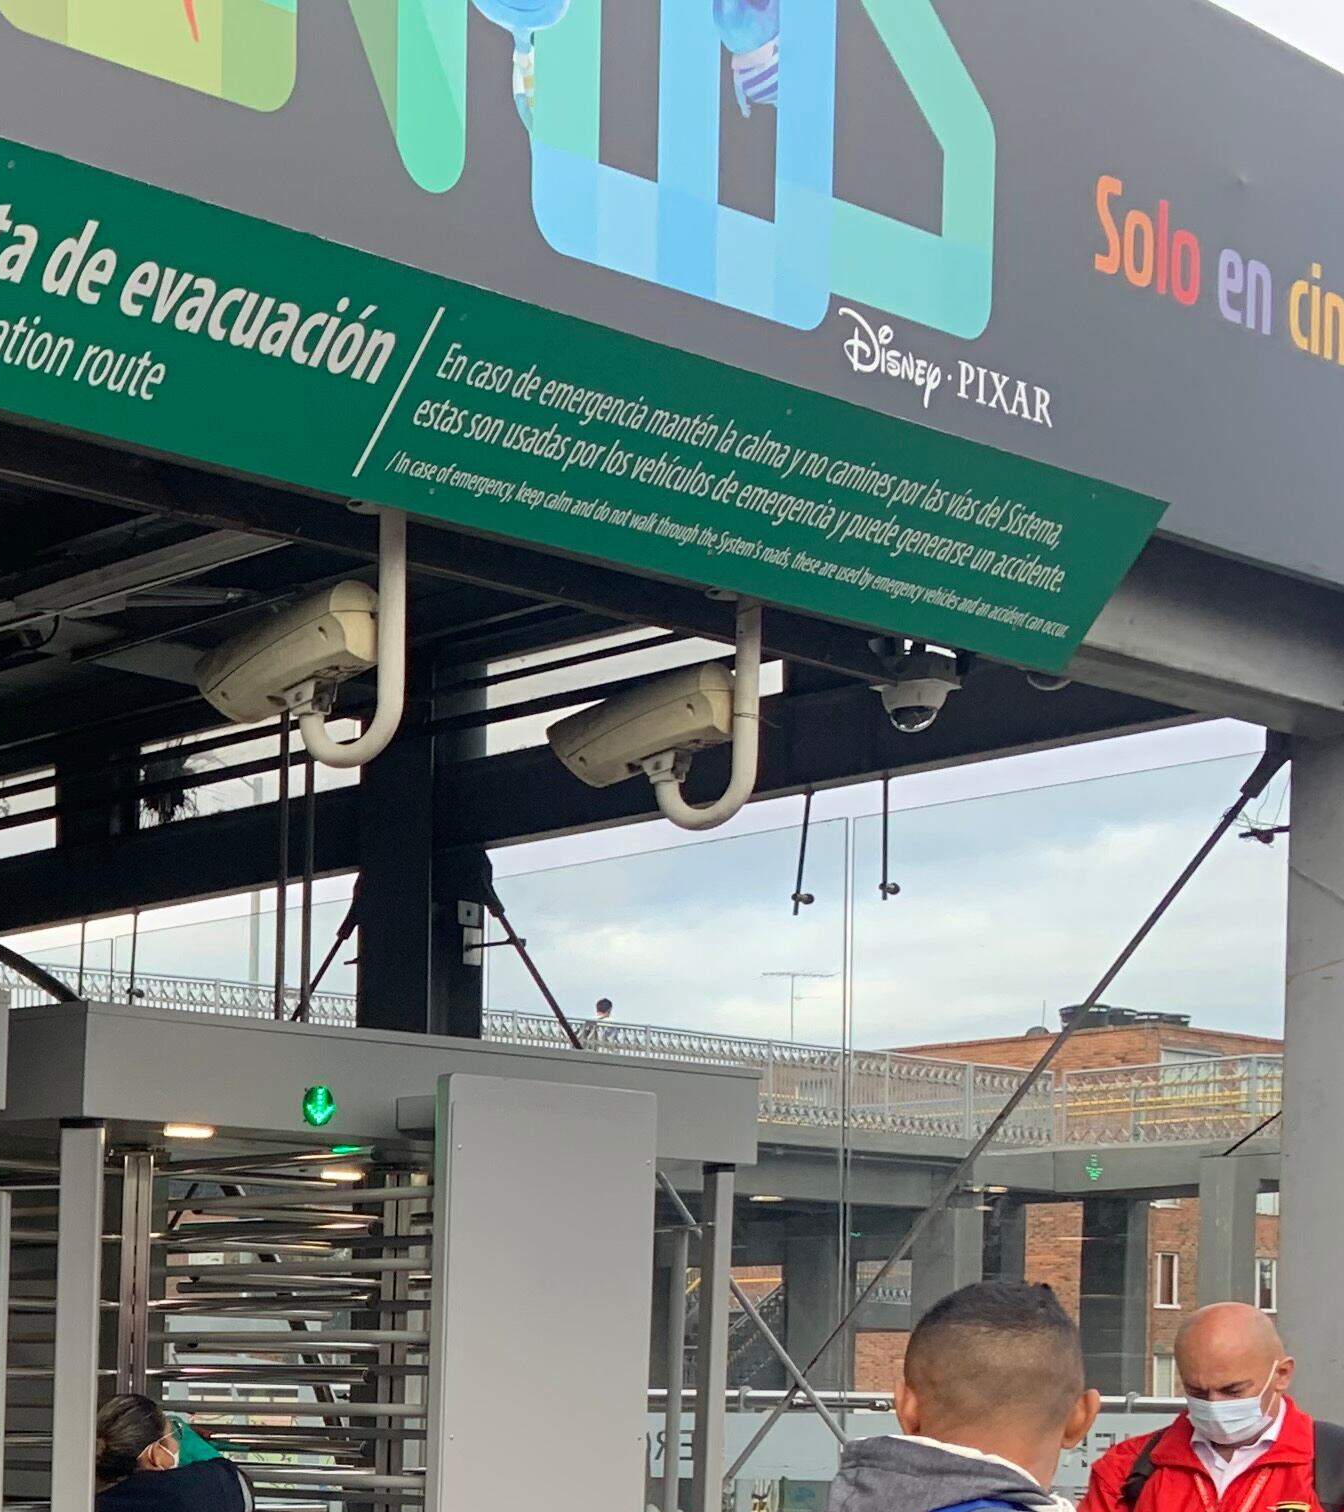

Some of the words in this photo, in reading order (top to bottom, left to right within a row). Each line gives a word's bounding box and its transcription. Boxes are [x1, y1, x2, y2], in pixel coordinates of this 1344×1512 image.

[41, 219, 117, 304] de
[119, 261, 396, 385] evacuación
[1094, 174, 1201, 305] Solo
[1218, 248, 1272, 335] en
[73, 343, 167, 401] route
[436, 343, 468, 382] En
[466, 360, 513, 393] caso
[511, 364, 542, 400] de
[539, 380, 648, 430] emergencia
[645, 409, 718, 448] mantén
[715, 419, 737, 454] la
[735, 430, 790, 468] calma
[781, 448, 805, 479] y
[800, 453, 828, 478] no
[825, 462, 897, 497] camines
[886, 480, 927, 508] por
[920, 479, 949, 512] las
[945, 489, 980, 521] vías
[975, 496, 1011, 528] del
[999, 504, 1062, 550] Sistema,
[957, 360, 1053, 428] PIXAR
[409, 460, 437, 480] case
[436, 463, 457, 483] of
[450, 471, 515, 502] emergency,
[515, 481, 544, 510] keep
[543, 491, 573, 512] calm
[570, 499, 598, 518] and
[593, 501, 610, 522] do
[607, 510, 632, 527] not
[628, 512, 658, 533] walk
[655, 516, 700, 546] through
[697, 527, 719, 548] the
[715, 531, 763, 555] System's
[760, 547, 791, 569] roads,
[791, 551, 821, 573] these
[818, 562, 837, 578] are
[835, 566, 864, 584] used
[858, 567, 875, 591] by
[872, 576, 924, 604] emergency
[923, 587, 960, 610] vehicles
[957, 597, 982, 614] and
[975, 602, 991, 617] an
[988, 606, 1030, 627] accident
[1025, 616, 1044, 631] can
[413, 399, 468, 435] estas
[463, 413, 504, 445] son
[502, 422, 572, 460] usadas
[561, 440, 607, 472] por
[600, 439, 634, 476] los
[631, 452, 715, 497] vehículos
[711, 470, 738, 504] de
[736, 485, 836, 529] emergencia
[826, 510, 851, 539] y
[839, 513, 900, 546] puede
[890, 527, 974, 566] generarse
[970, 548, 995, 572] un
[990, 553, 1065, 592] accidente.
